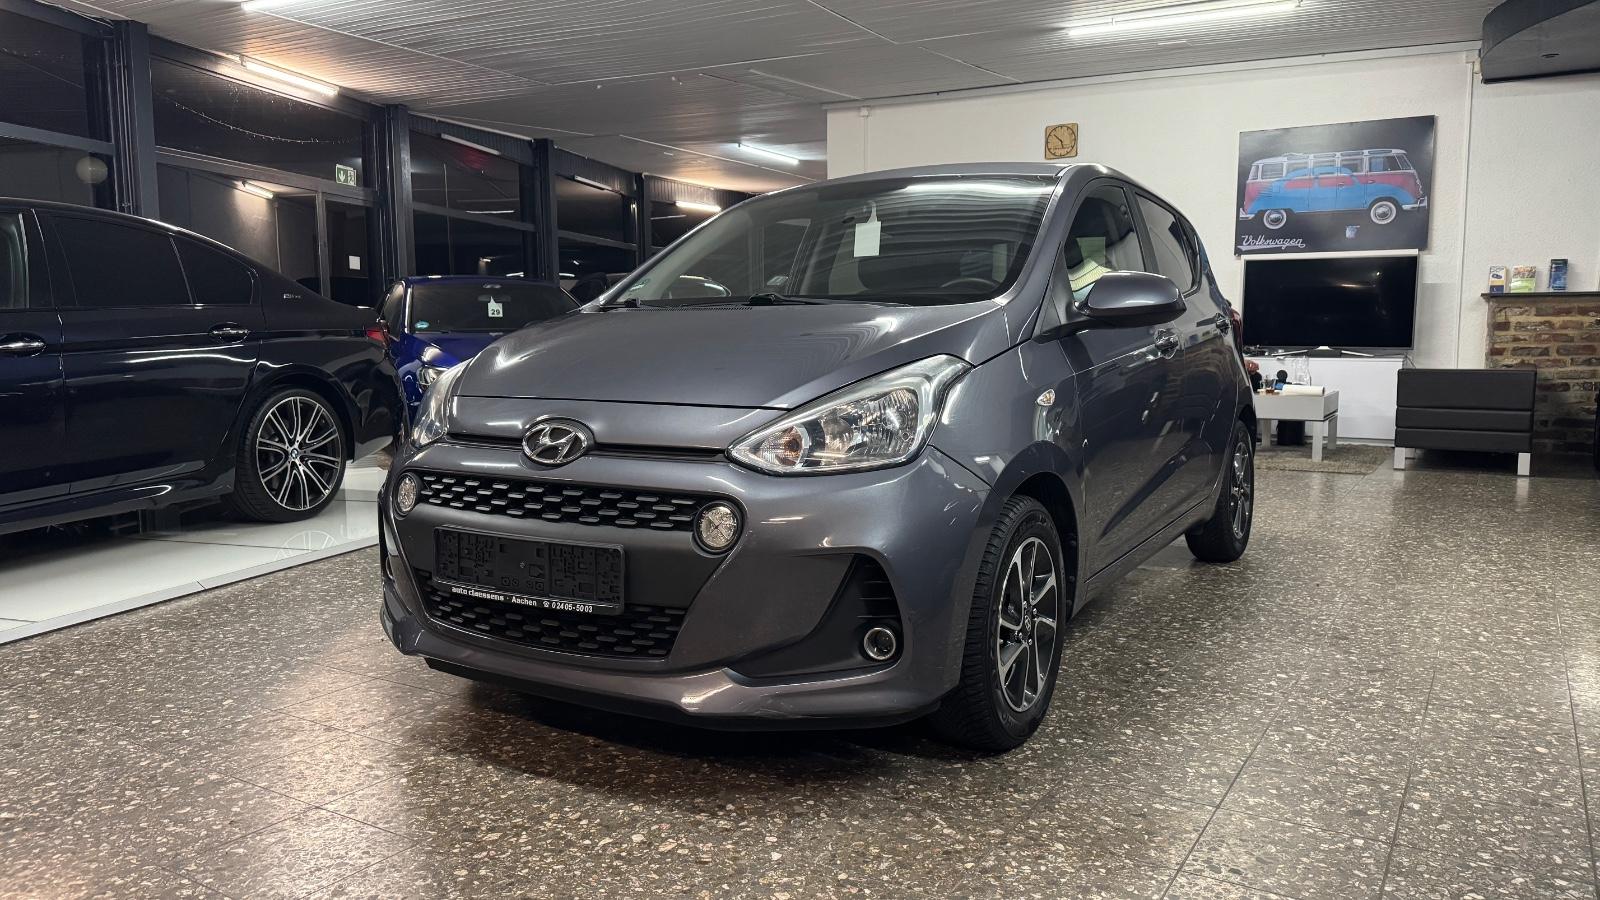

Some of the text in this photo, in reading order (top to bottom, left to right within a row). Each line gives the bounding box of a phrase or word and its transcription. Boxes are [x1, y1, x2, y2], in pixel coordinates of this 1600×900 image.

[1240, 234, 1306, 250] Volkswagen
[490, 308, 501, 316] 29
[451, 587, 469, 596] auto
[512, 596, 538, 607] Aachen
